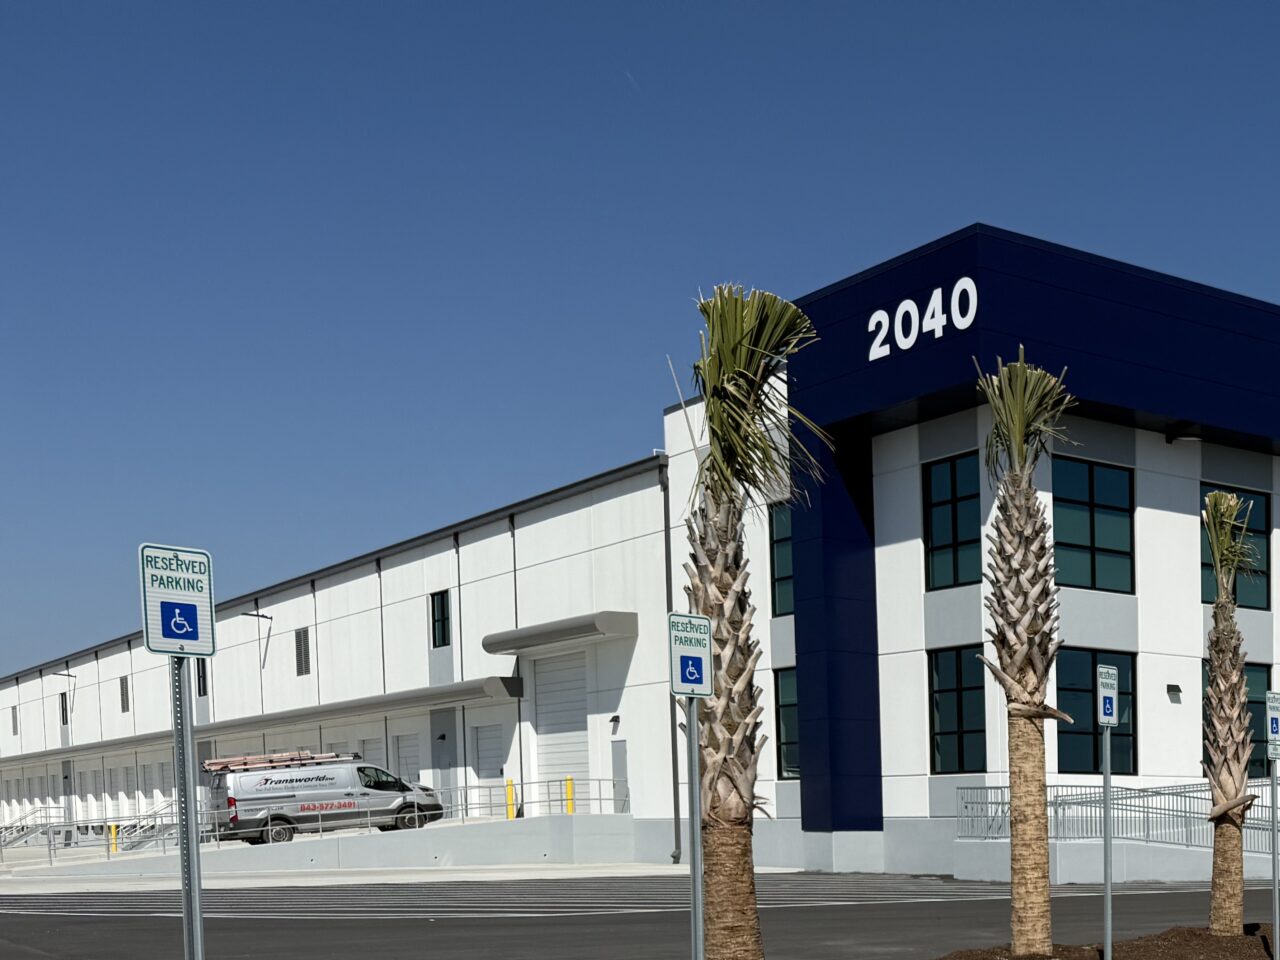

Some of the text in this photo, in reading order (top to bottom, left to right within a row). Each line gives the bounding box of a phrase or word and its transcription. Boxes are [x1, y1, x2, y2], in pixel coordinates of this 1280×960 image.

[867, 276, 978, 362] 2040
[145, 555, 207, 575] RESERVED
[151, 574, 204, 593] PARKING
[671, 620, 708, 635] RESERVED
[674, 635, 707, 649] PARKING
[263, 775, 326, 785] Transworld
